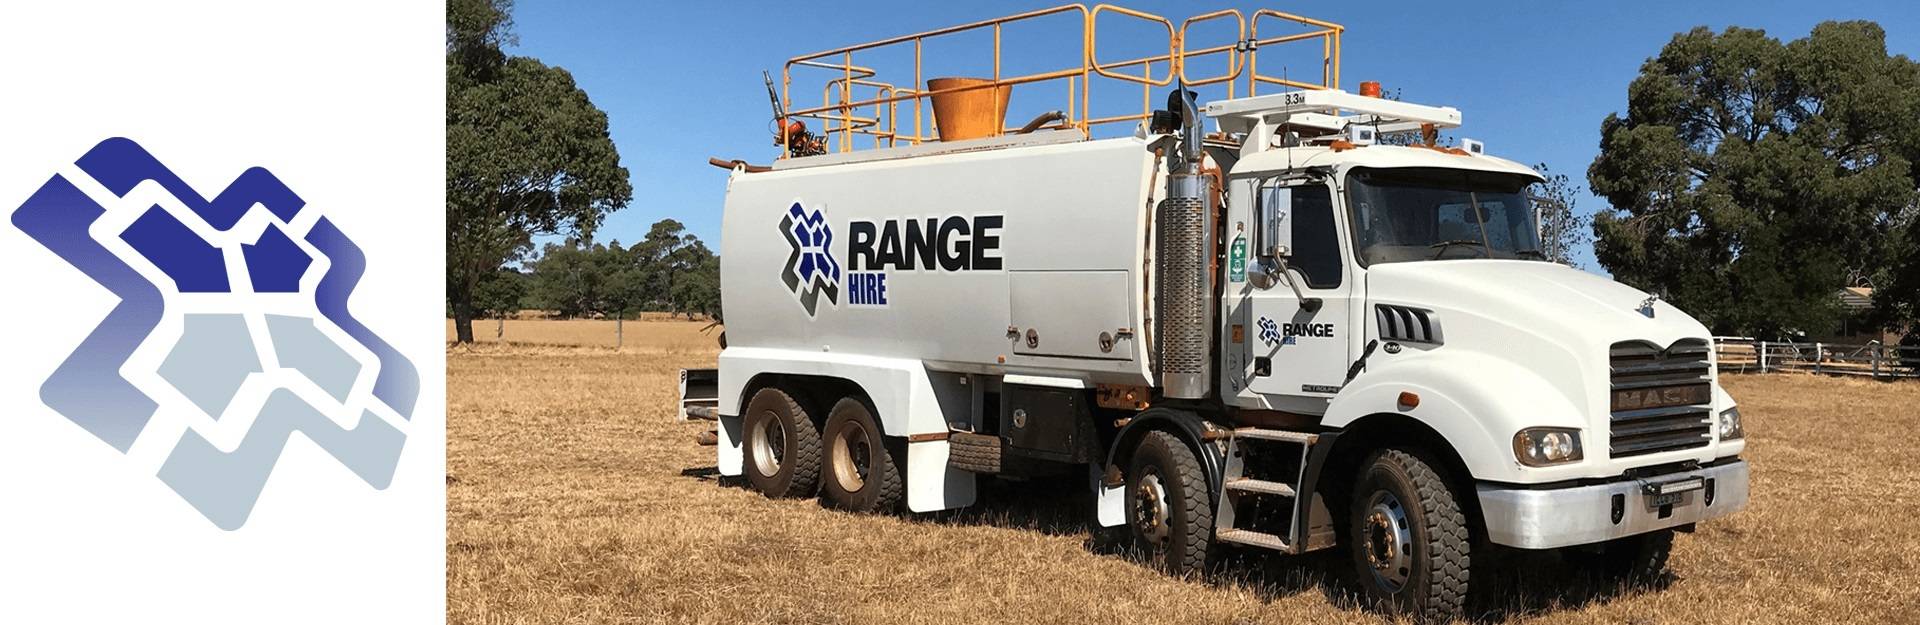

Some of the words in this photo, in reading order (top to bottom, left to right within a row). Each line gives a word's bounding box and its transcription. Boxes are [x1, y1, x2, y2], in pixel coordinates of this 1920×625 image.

[848, 215, 1003, 271] RANGE
[848, 273, 887, 304] HIRE
[1283, 323, 1334, 337] RANGE
